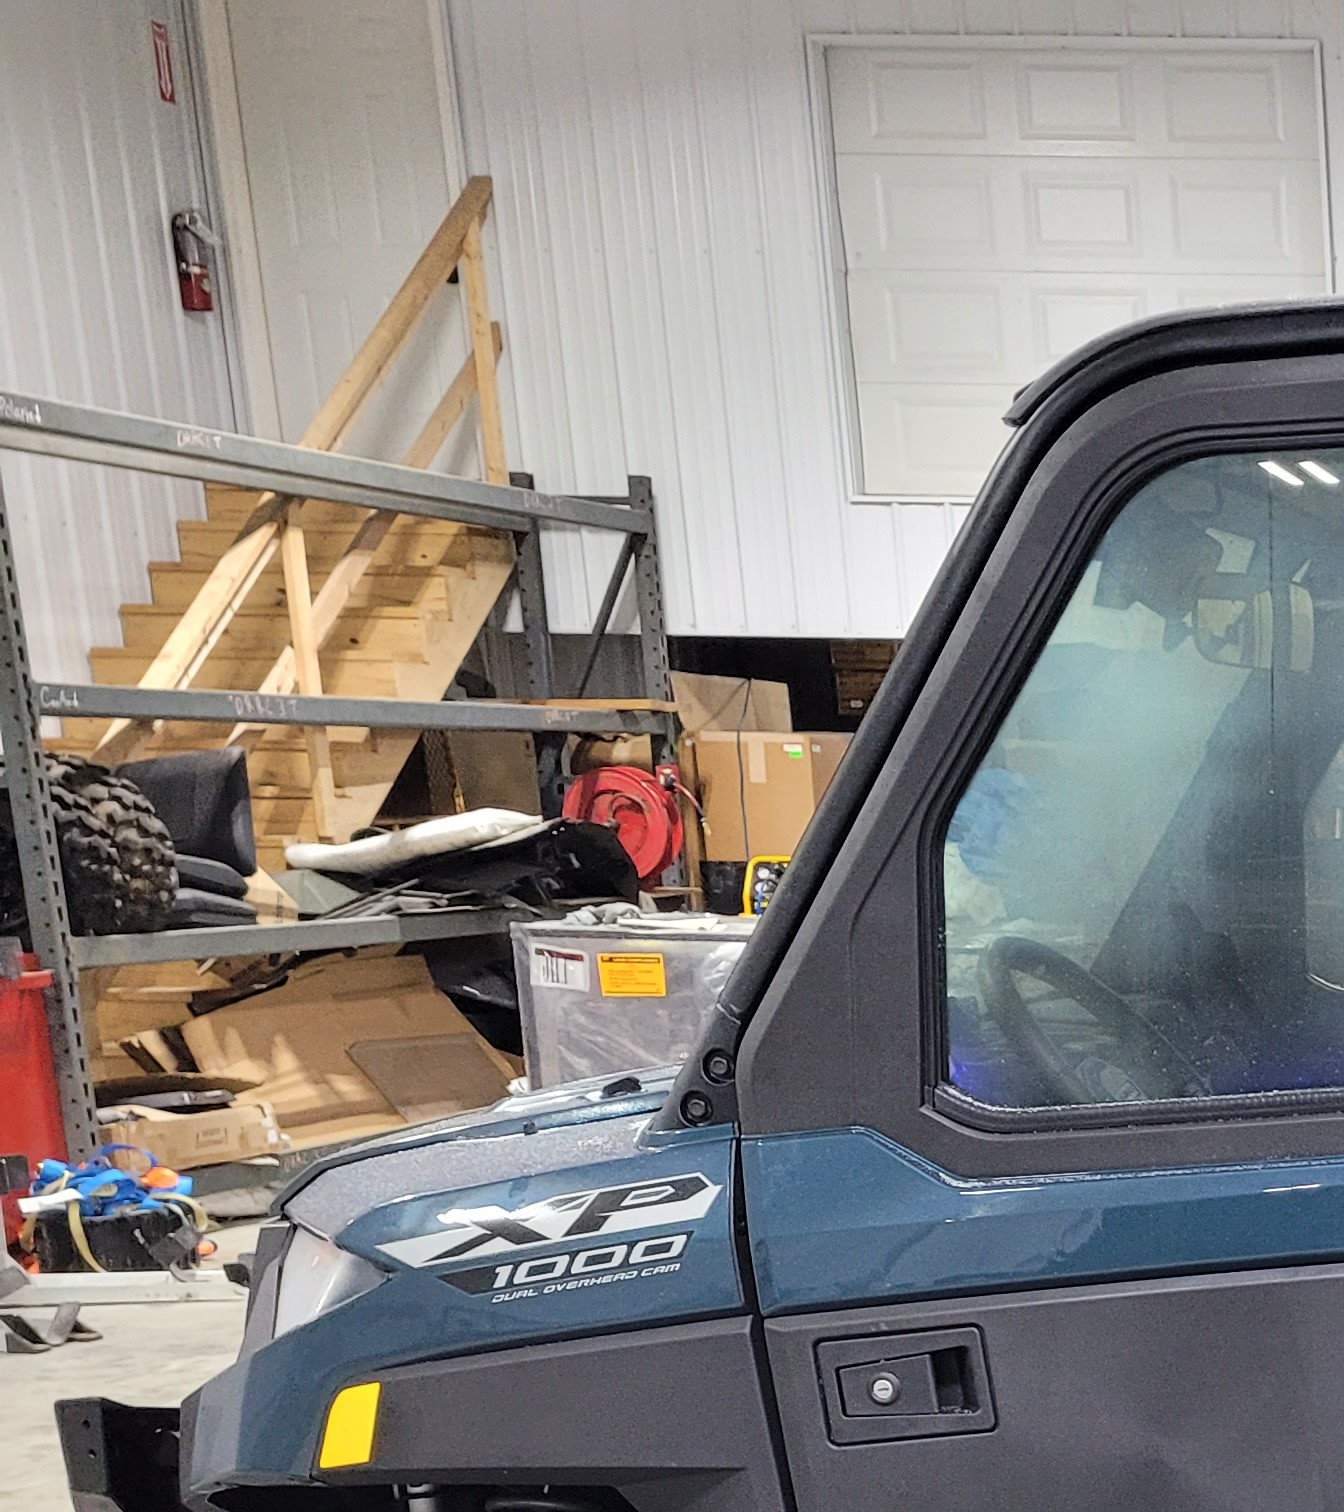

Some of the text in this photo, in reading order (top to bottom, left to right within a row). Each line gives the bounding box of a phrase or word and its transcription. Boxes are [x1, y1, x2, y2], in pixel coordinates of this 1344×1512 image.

[420, 1175, 709, 1264] XP
[491, 1262, 681, 1304] DUAL OVERHEAD CAM
[492, 1234, 688, 1289] 1000
